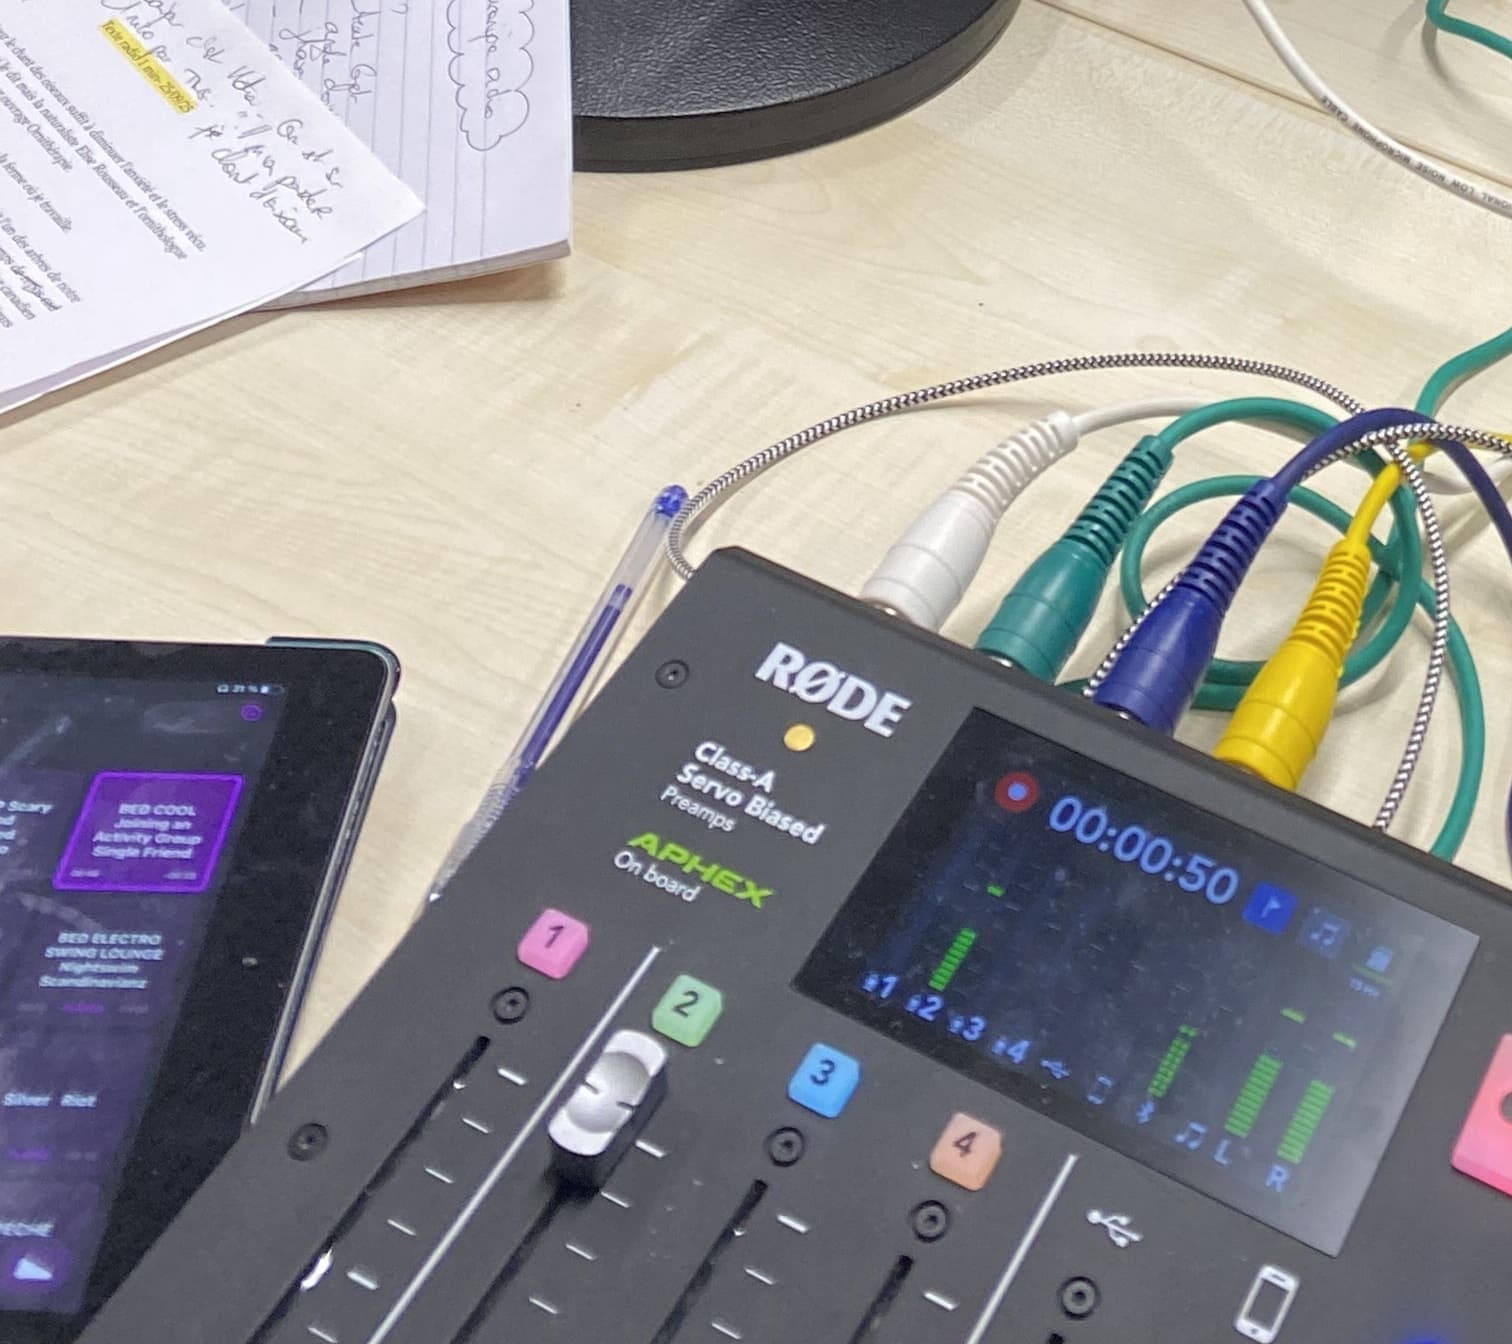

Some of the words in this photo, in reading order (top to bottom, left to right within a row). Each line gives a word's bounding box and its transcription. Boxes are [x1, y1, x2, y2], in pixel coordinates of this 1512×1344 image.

[755, 641, 913, 739] RØDE
[694, 740, 777, 794] Class-A
[660, 785, 737, 833] Preamps
[676, 763, 743, 807] Servo
[744, 794, 826, 846] Biased
[613, 850, 642, 877] On
[643, 863, 702, 904] board
[626, 832, 775, 909] APHEX
[1047, 795, 1241, 906] 00:00:50
[542, 925, 567, 949] 1
[672, 989, 701, 1018] 2
[809, 1058, 837, 1087] 3
[951, 1131, 978, 1157] 4
